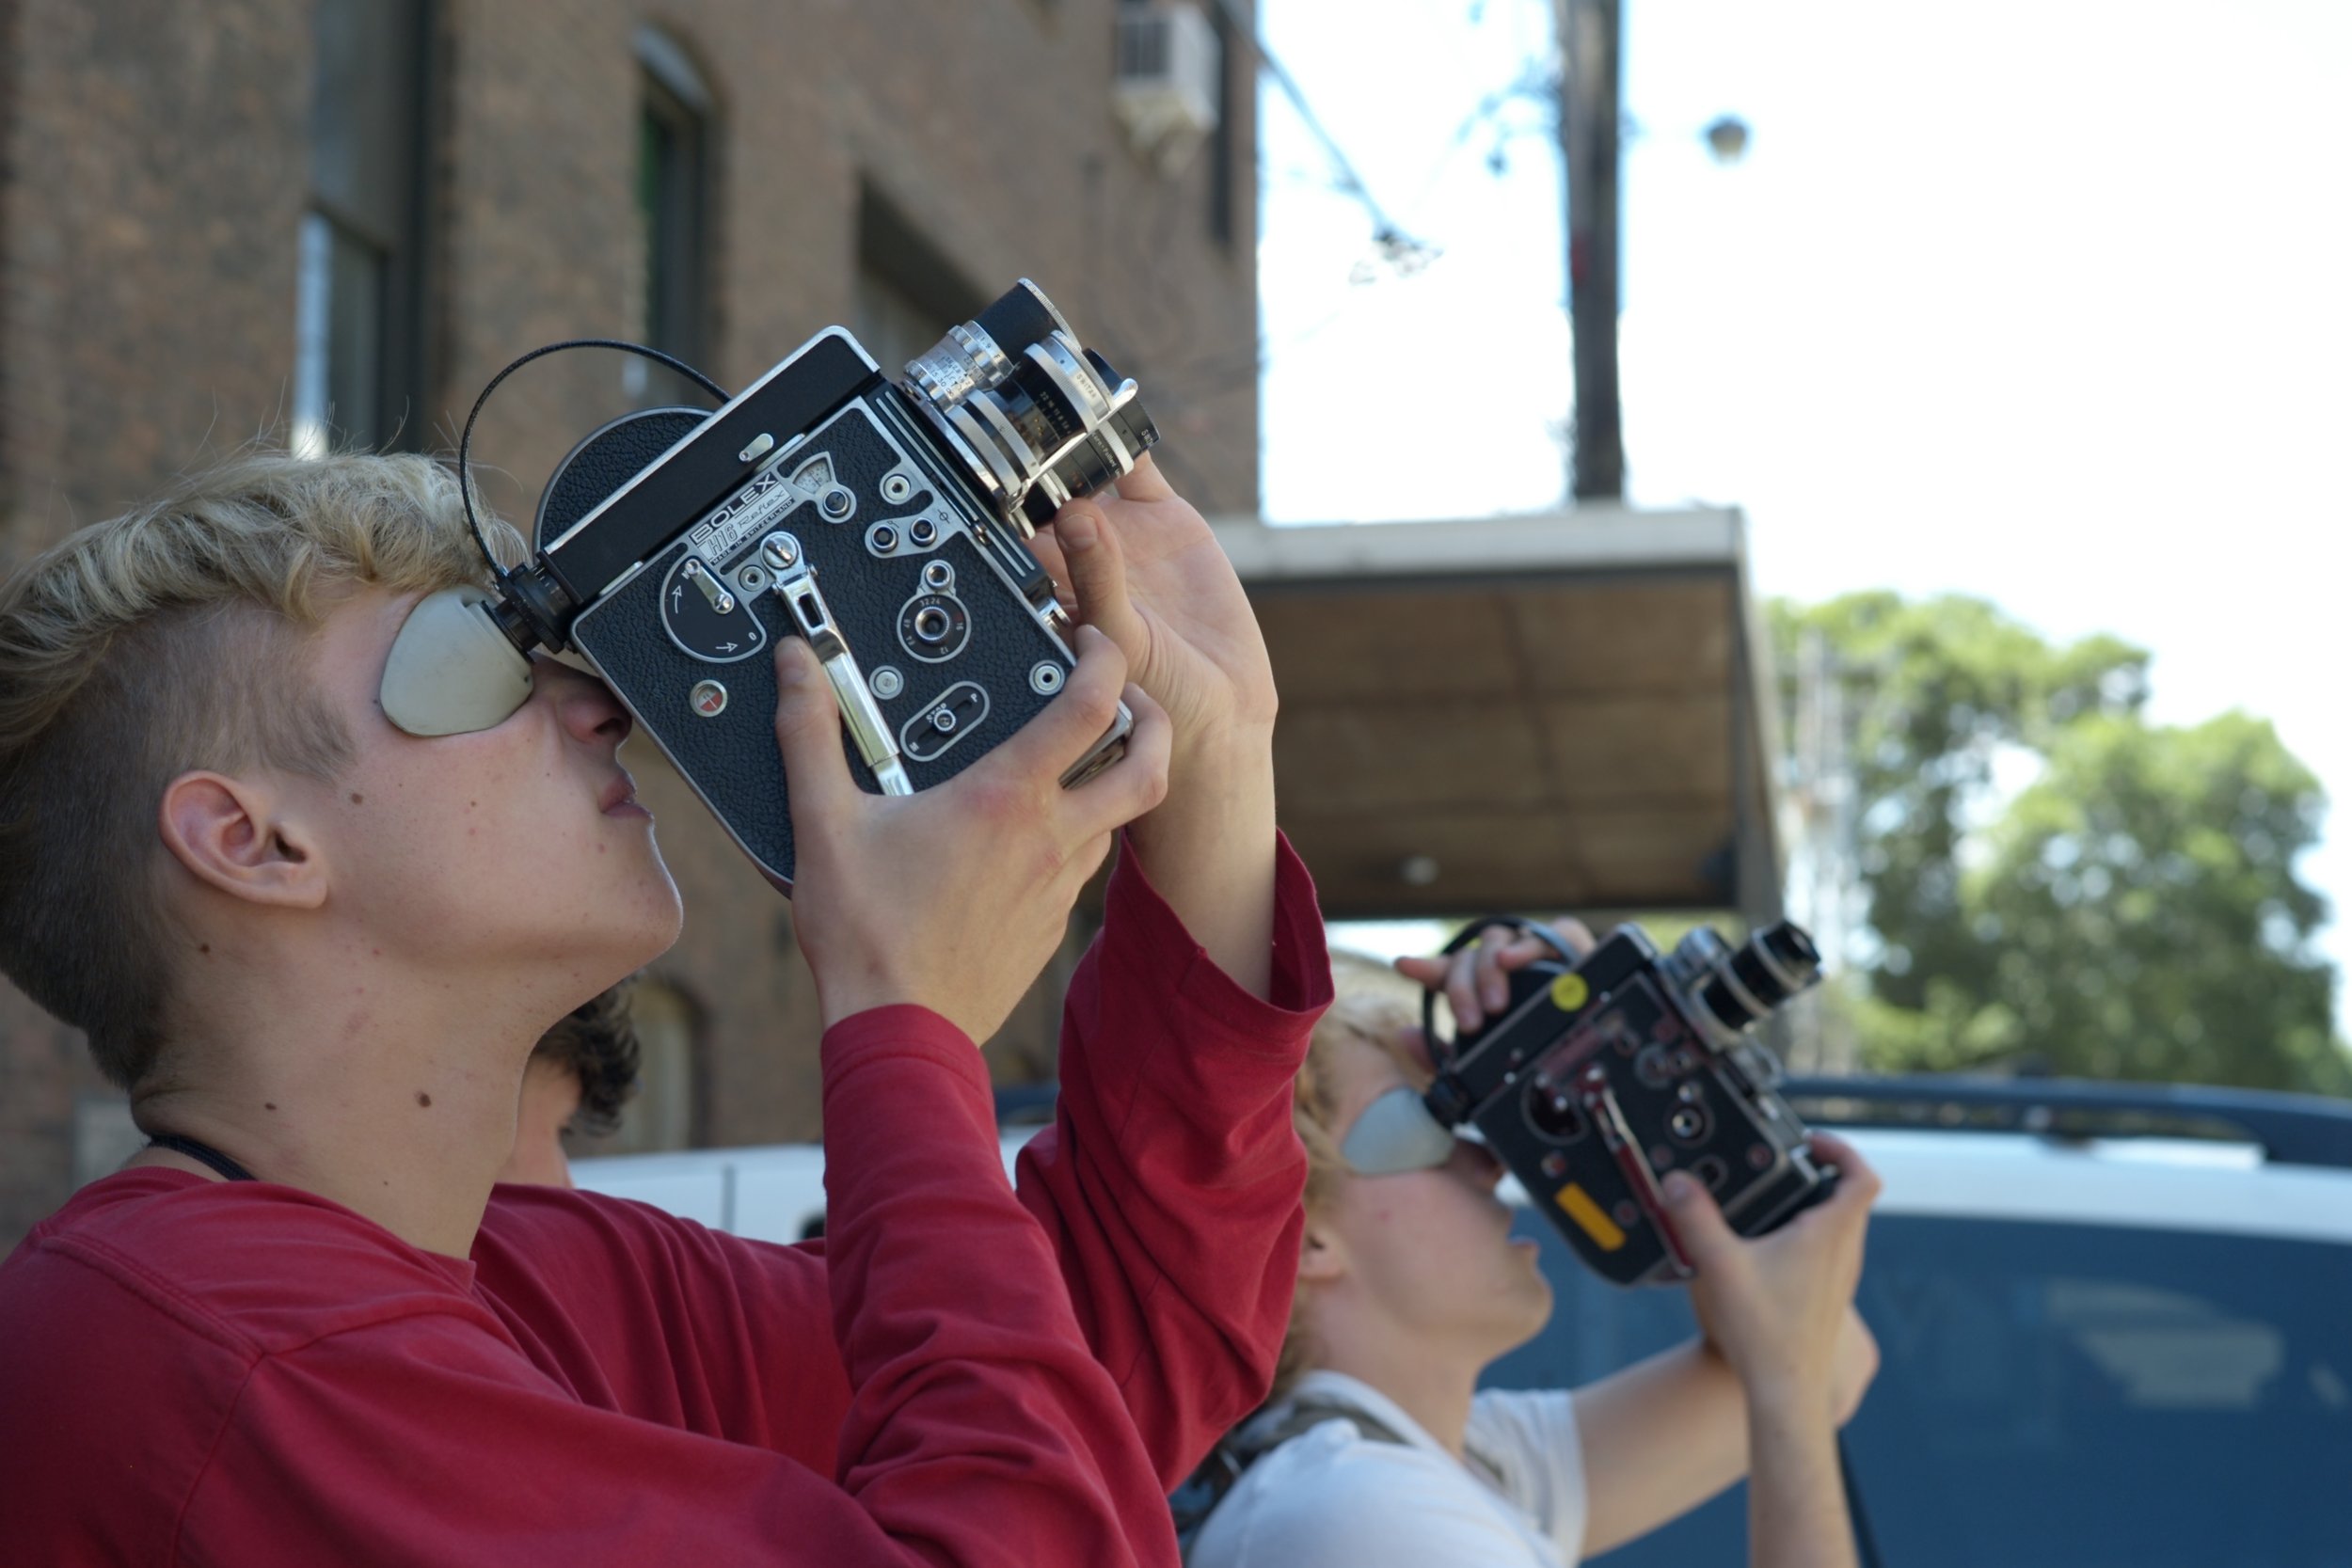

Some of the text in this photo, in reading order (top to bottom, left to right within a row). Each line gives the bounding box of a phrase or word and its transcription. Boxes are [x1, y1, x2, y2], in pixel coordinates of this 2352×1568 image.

[690, 473, 776, 545] BOLEX
[707, 490, 786, 557] H16 Reflex
[712, 499, 793, 564] MADE IN SWITZERLAND
[970, 693, 977, 703] P
